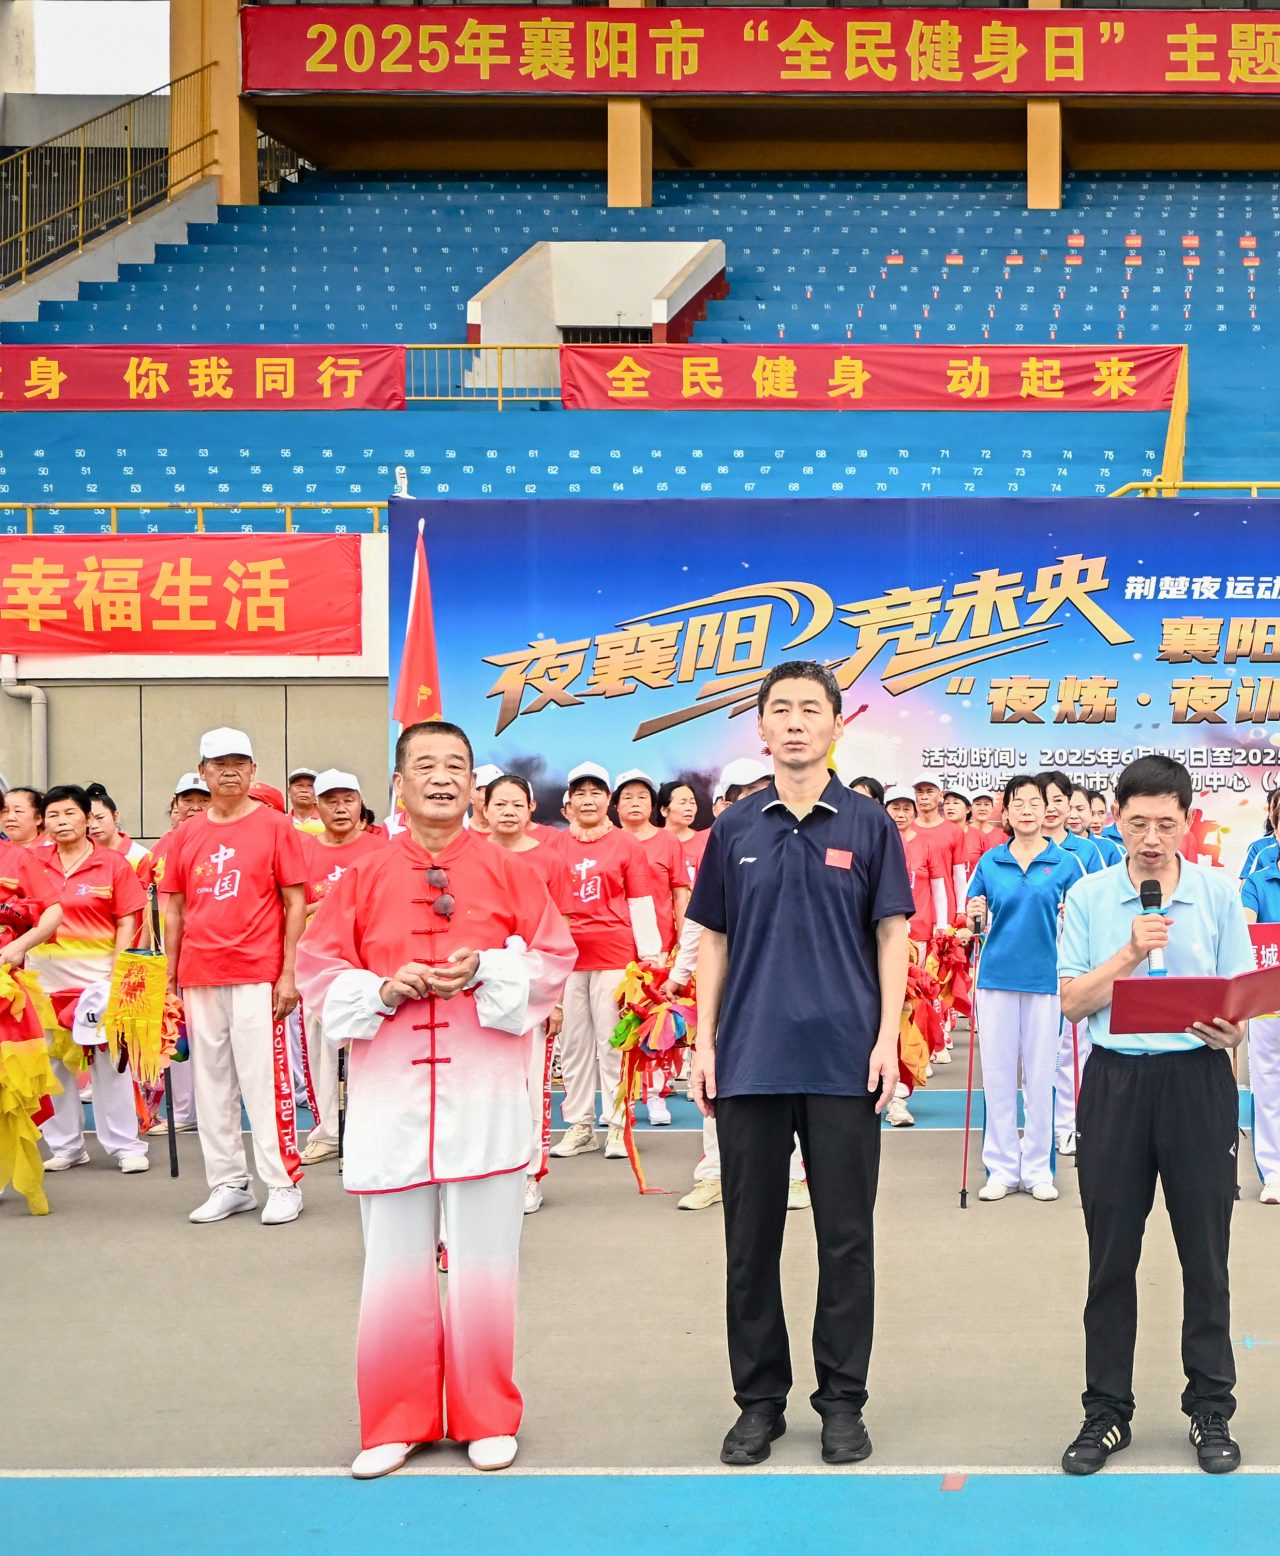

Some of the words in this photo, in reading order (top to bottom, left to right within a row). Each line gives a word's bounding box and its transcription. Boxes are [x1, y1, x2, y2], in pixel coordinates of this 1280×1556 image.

[306, 17, 705, 81] 2025年襄阳市
[743, 20, 1125, 83] “全民健身日”
[0, 356, 68, 400] 身
[123, 355, 363, 400] 你我同行
[607, 355, 871, 399] 全民健身
[946, 356, 1137, 399] 动起来
[33, 449, 45, 458] 49
[74, 448, 86, 458] 50
[116, 448, 127, 457] 51
[157, 448, 168, 457] 52
[198, 448, 209, 458] 53
[239, 448, 250, 458] 54
[280, 448, 292, 458] 55
[321, 449, 333, 458] 56
[363, 448, 374, 458] 57
[404, 448, 416, 458] 58
[445, 449, 457, 459] 59
[486, 449, 498, 459] 60
[528, 449, 539, 458] 61
[568, 449, 581, 459] 62
[609, 449, 622, 459] 63
[651, 449, 662, 458] 64
[691, 449, 704, 458] 65
[733, 449, 745, 458] 66
[774, 449, 785, 459] 67
[815, 449, 827, 459] 68
[856, 449, 868, 458] 69
[898, 449, 909, 458] 70
[939, 449, 950, 458] 71
[980, 449, 992, 459] 72
[1021, 449, 1033, 459] 73
[1062, 449, 1073, 460] 74
[1103, 450, 1115, 462] 75
[1144, 450, 1156, 460] 76
[37, 466, 49, 476] 50
[80, 466, 91, 475] 51
[122, 466, 134, 476] 52
[165, 466, 177, 476] 53
[437, 483, 450, 493] 60
[481, 483, 492, 493] 61
[524, 483, 537, 494] 62
[568, 483, 581, 493] 63
[612, 482, 625, 492] 64
[656, 482, 669, 492] 65
[700, 482, 713, 492] 66
[744, 482, 756, 492] 67
[788, 482, 800, 492] 68
[831, 482, 844, 491] 69
[876, 482, 888, 492] 70
[920, 482, 931, 491] 71
[964, 482, 975, 492] 72
[1007, 482, 1019, 492] 73
[1050, 483, 1062, 492] 74
[1, 556, 290, 632] 幸福生活
[208, 843, 241, 901] 中国
[574, 857, 602, 903] 中国
